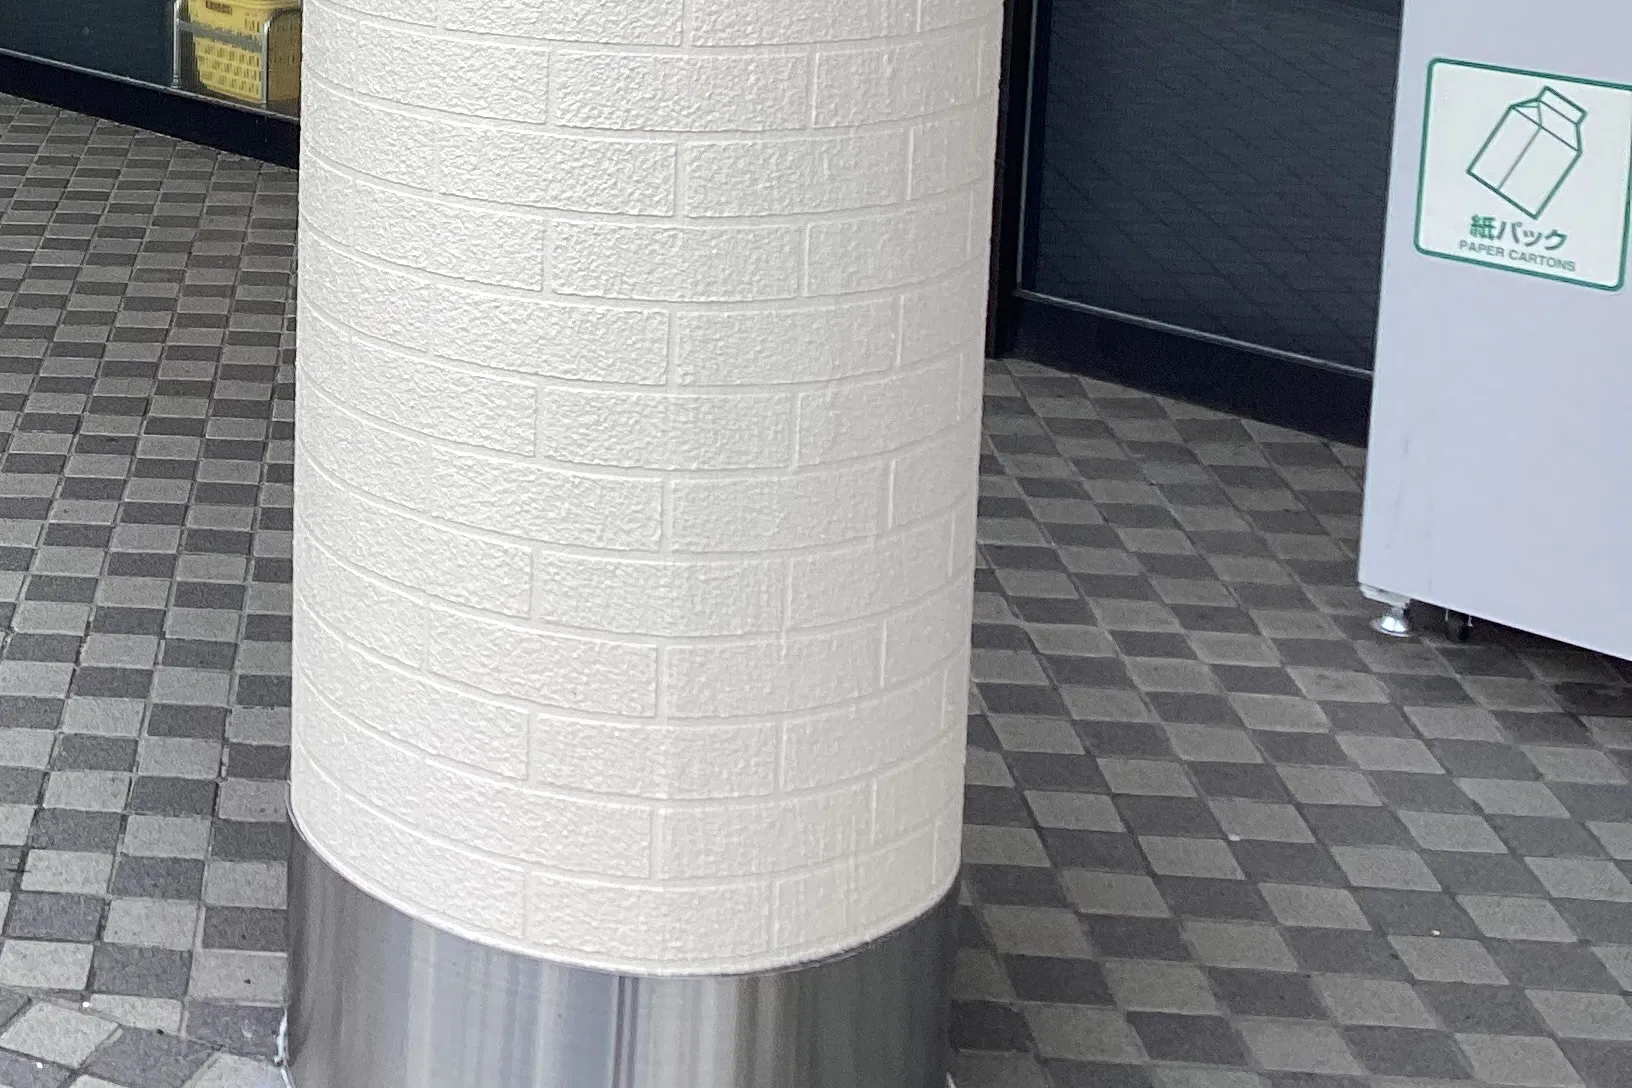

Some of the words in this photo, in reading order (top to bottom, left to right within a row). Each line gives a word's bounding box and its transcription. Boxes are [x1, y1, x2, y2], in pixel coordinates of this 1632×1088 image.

[1469, 213, 1568, 251] 紙パック
[1459, 239, 1505, 259] PAPER
[1508, 249, 1576, 272] CARTONS
